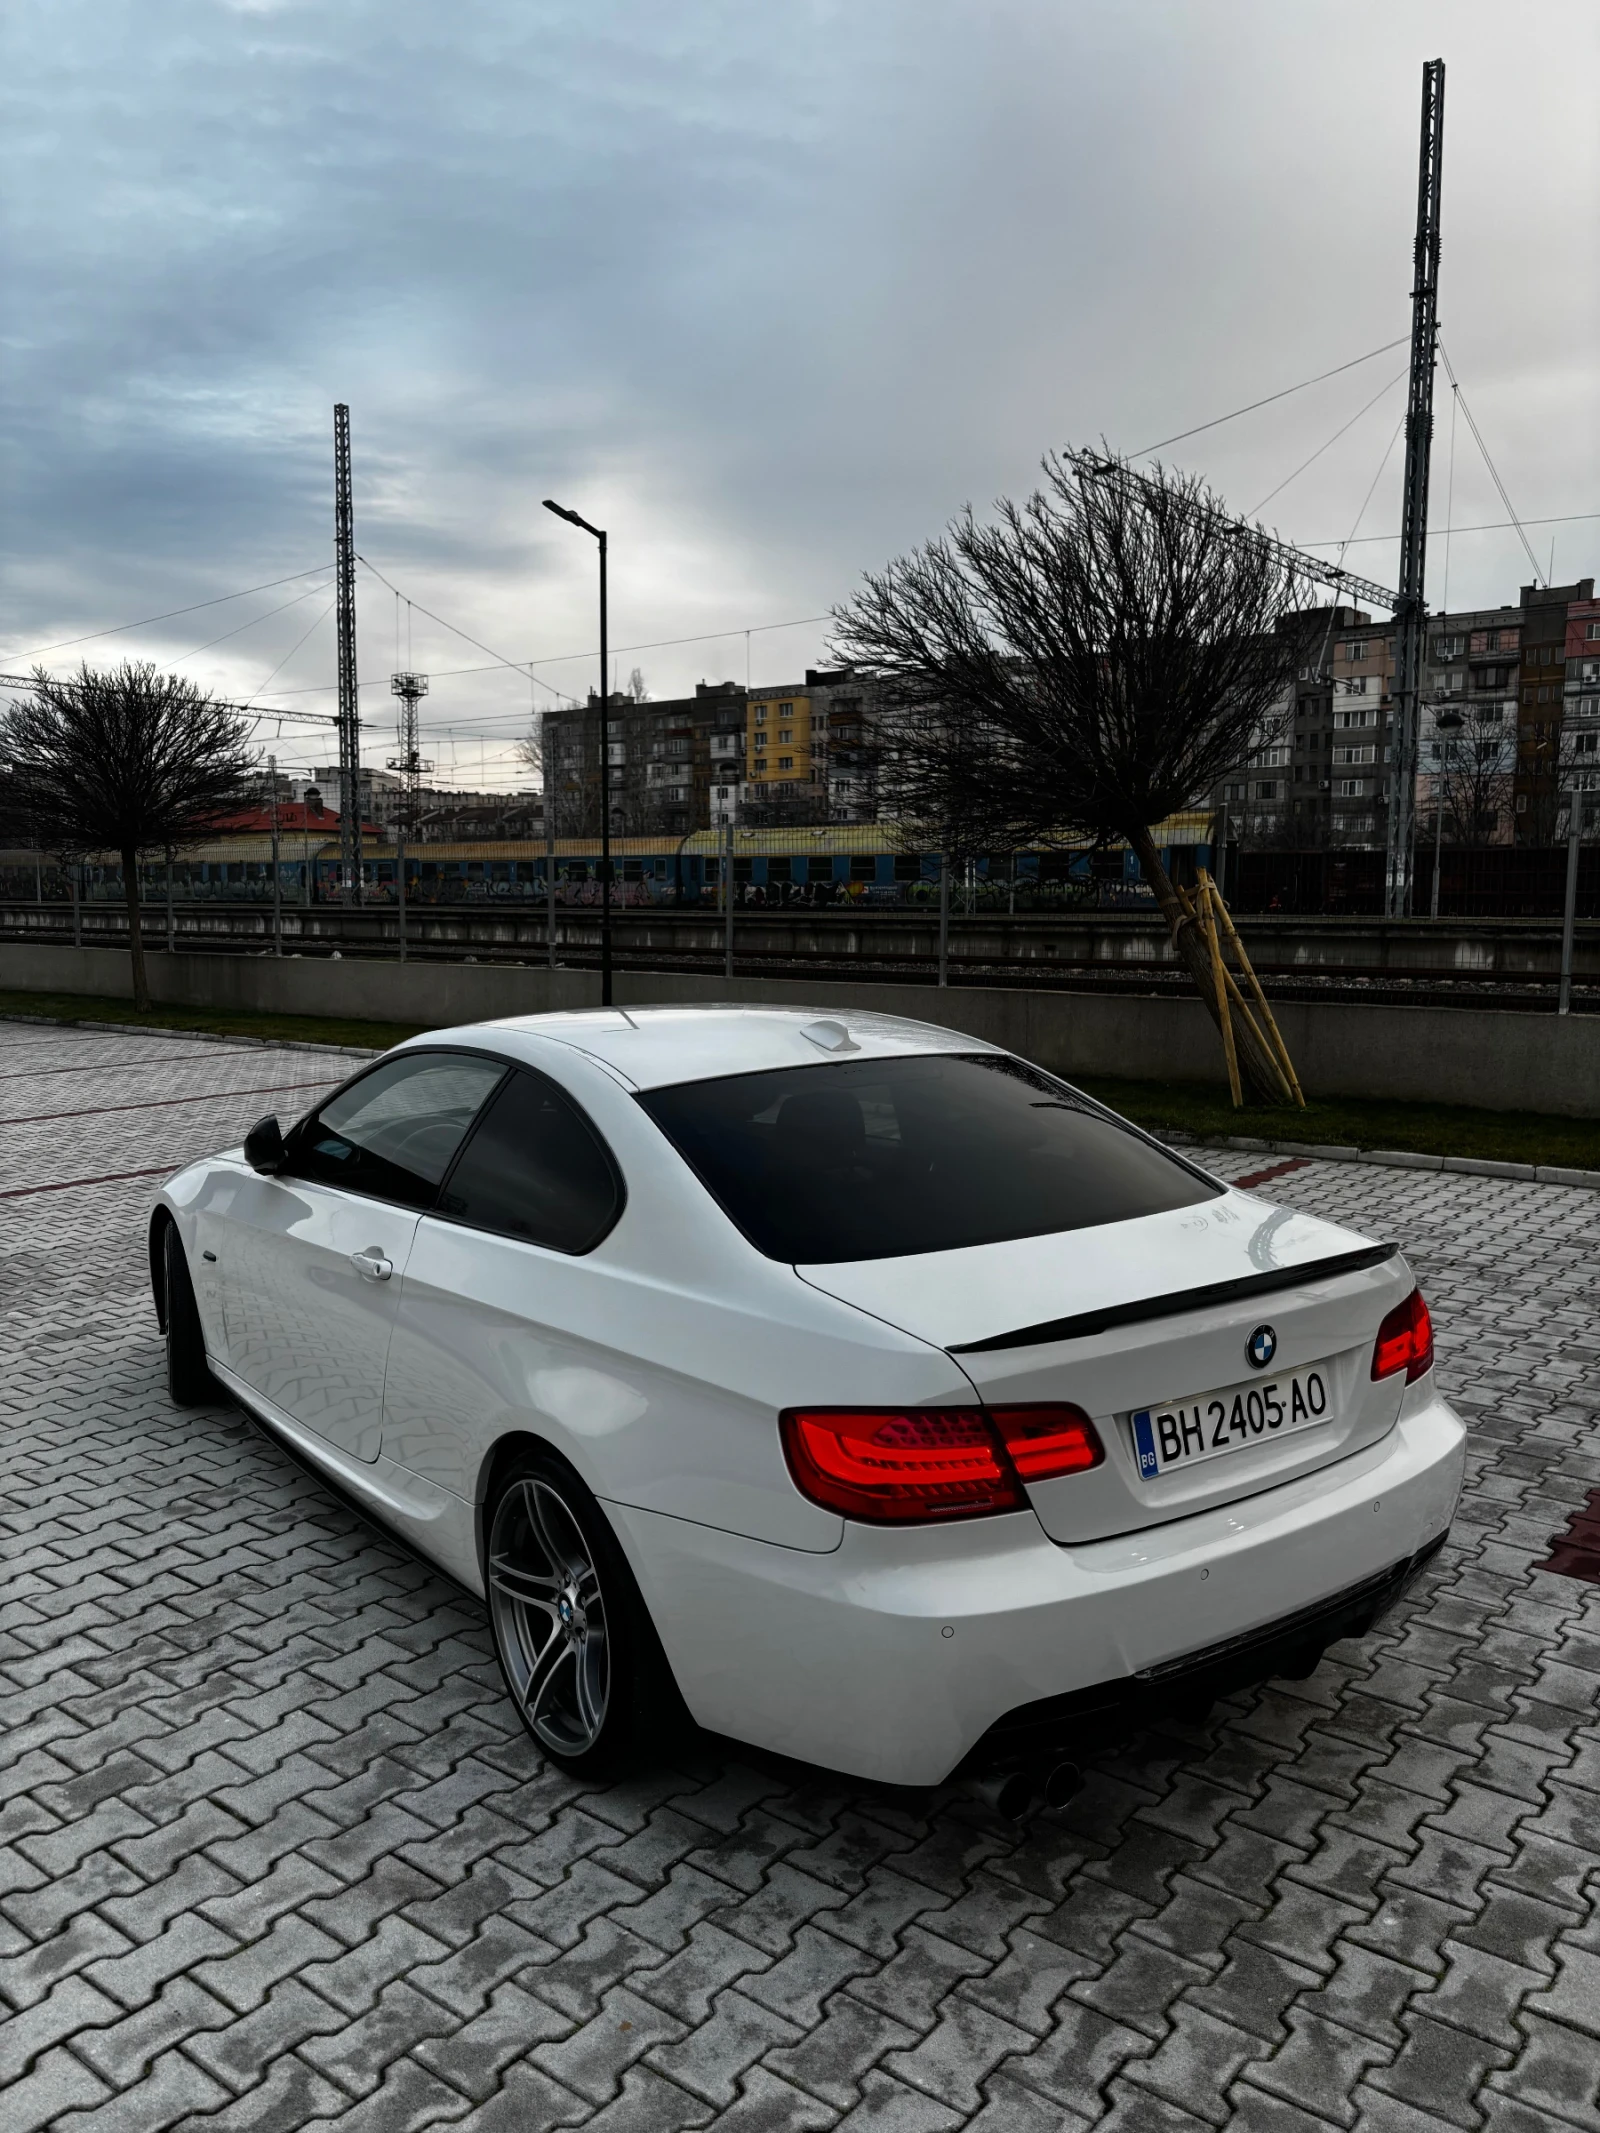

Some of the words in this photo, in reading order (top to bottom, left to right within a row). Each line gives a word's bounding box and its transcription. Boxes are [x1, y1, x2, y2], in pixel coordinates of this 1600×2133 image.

[1157, 1406, 1205, 1463] BH
[1207, 1384, 1283, 1447] 2405
[1292, 1373, 1326, 1423] AO
[1141, 1452, 1155, 1469] BG
